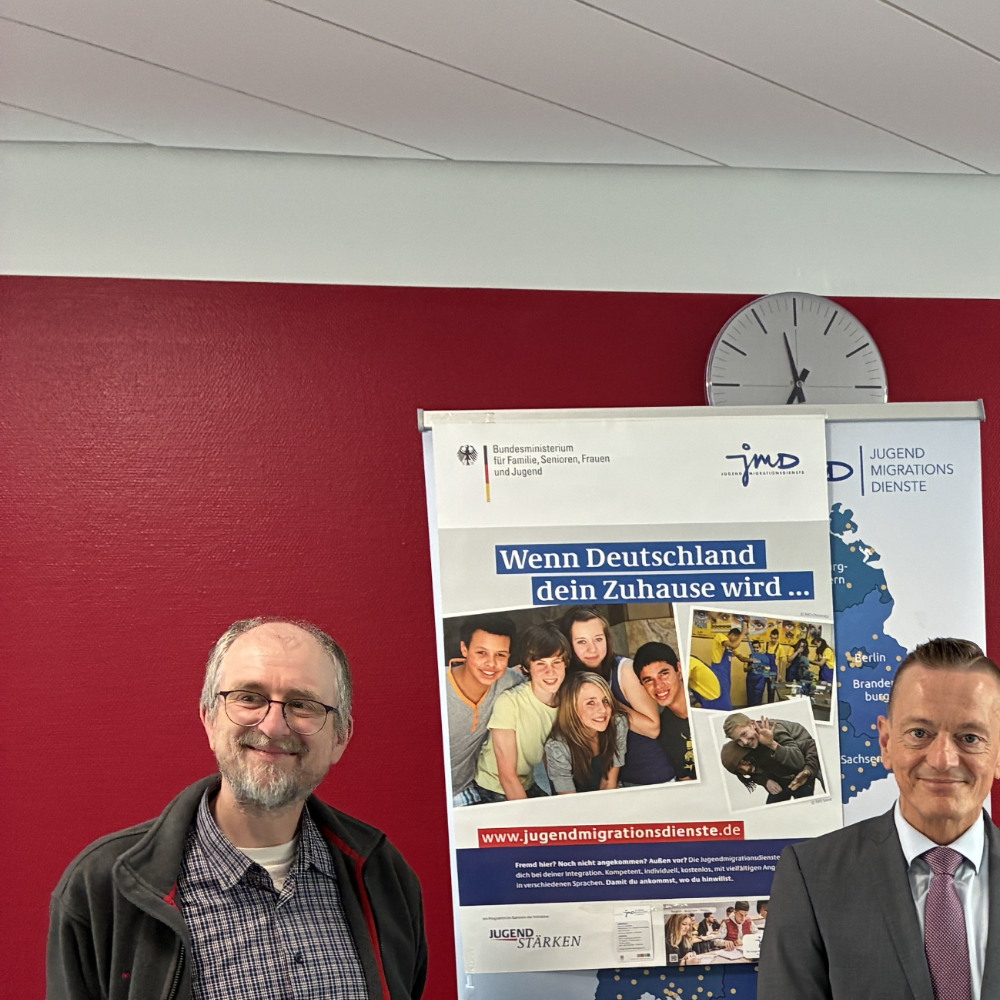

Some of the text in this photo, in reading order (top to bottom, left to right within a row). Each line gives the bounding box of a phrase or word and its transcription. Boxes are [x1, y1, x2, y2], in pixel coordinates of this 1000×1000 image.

[493, 444, 574, 454] Bundesministerium
[870, 447, 925, 460] JUGEND
[493, 453, 610, 466] für Familie, Senioren, Frauen
[494, 467, 543, 478] und Jugend
[870, 463, 954, 476] MIGRATIONS
[871, 480, 927, 493] DIENSTE
[500, 544, 756, 570] Wenn Deutschland
[536, 579, 597, 602] dein
[602, 577, 716, 601] Zuhause
[721, 576, 782, 599] wird
[854, 652, 886, 663] Berlin
[865, 691, 890, 703] burg
[482, 824, 741, 845] www.jugendmigrationsdienste.de
[539, 860, 556, 868] hier?
[597, 858, 648, 867] angekommen?
[516, 871, 531, 879] dich
[531, 870, 542, 878] bei
[565, 869, 604, 879] Integration.
[605, 868, 643, 877] Kompetent,
[681, 866, 713, 874] kostenlos,
[523, 880, 572, 889] verschiedenen
[572, 878, 605, 889] Sprachen.
[606, 878, 628, 886] Damit
[639, 876, 678, 885] ankommst,
[702, 875, 734, 883] hinwillst.
[489, 928, 535, 939] JUGEND
[517, 935, 581, 949] STÄRKEN
